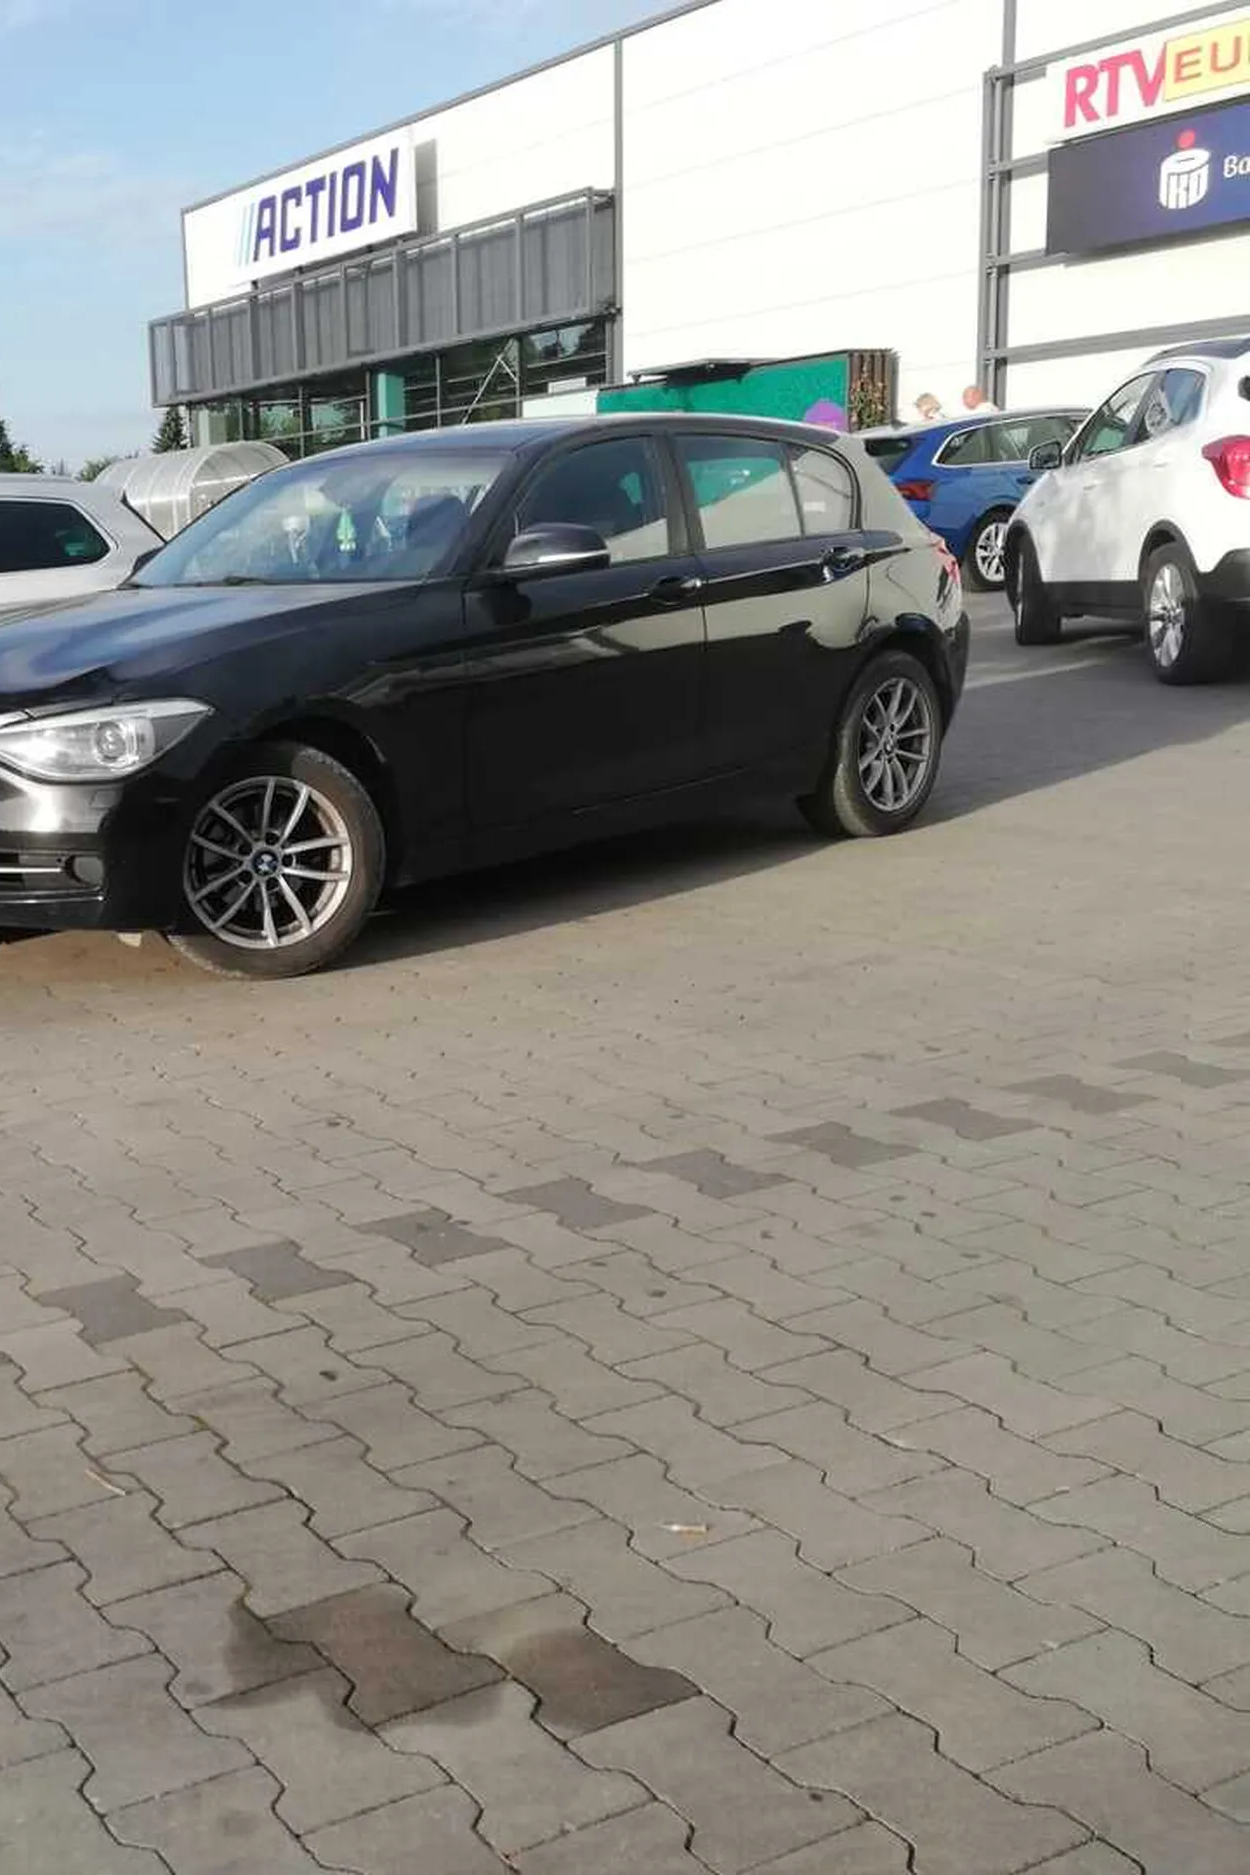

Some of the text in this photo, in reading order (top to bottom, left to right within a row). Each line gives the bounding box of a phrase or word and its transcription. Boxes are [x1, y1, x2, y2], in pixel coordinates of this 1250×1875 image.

[1064, 35, 1250, 128] RTV EU
[252, 147, 399, 262] ACTION
